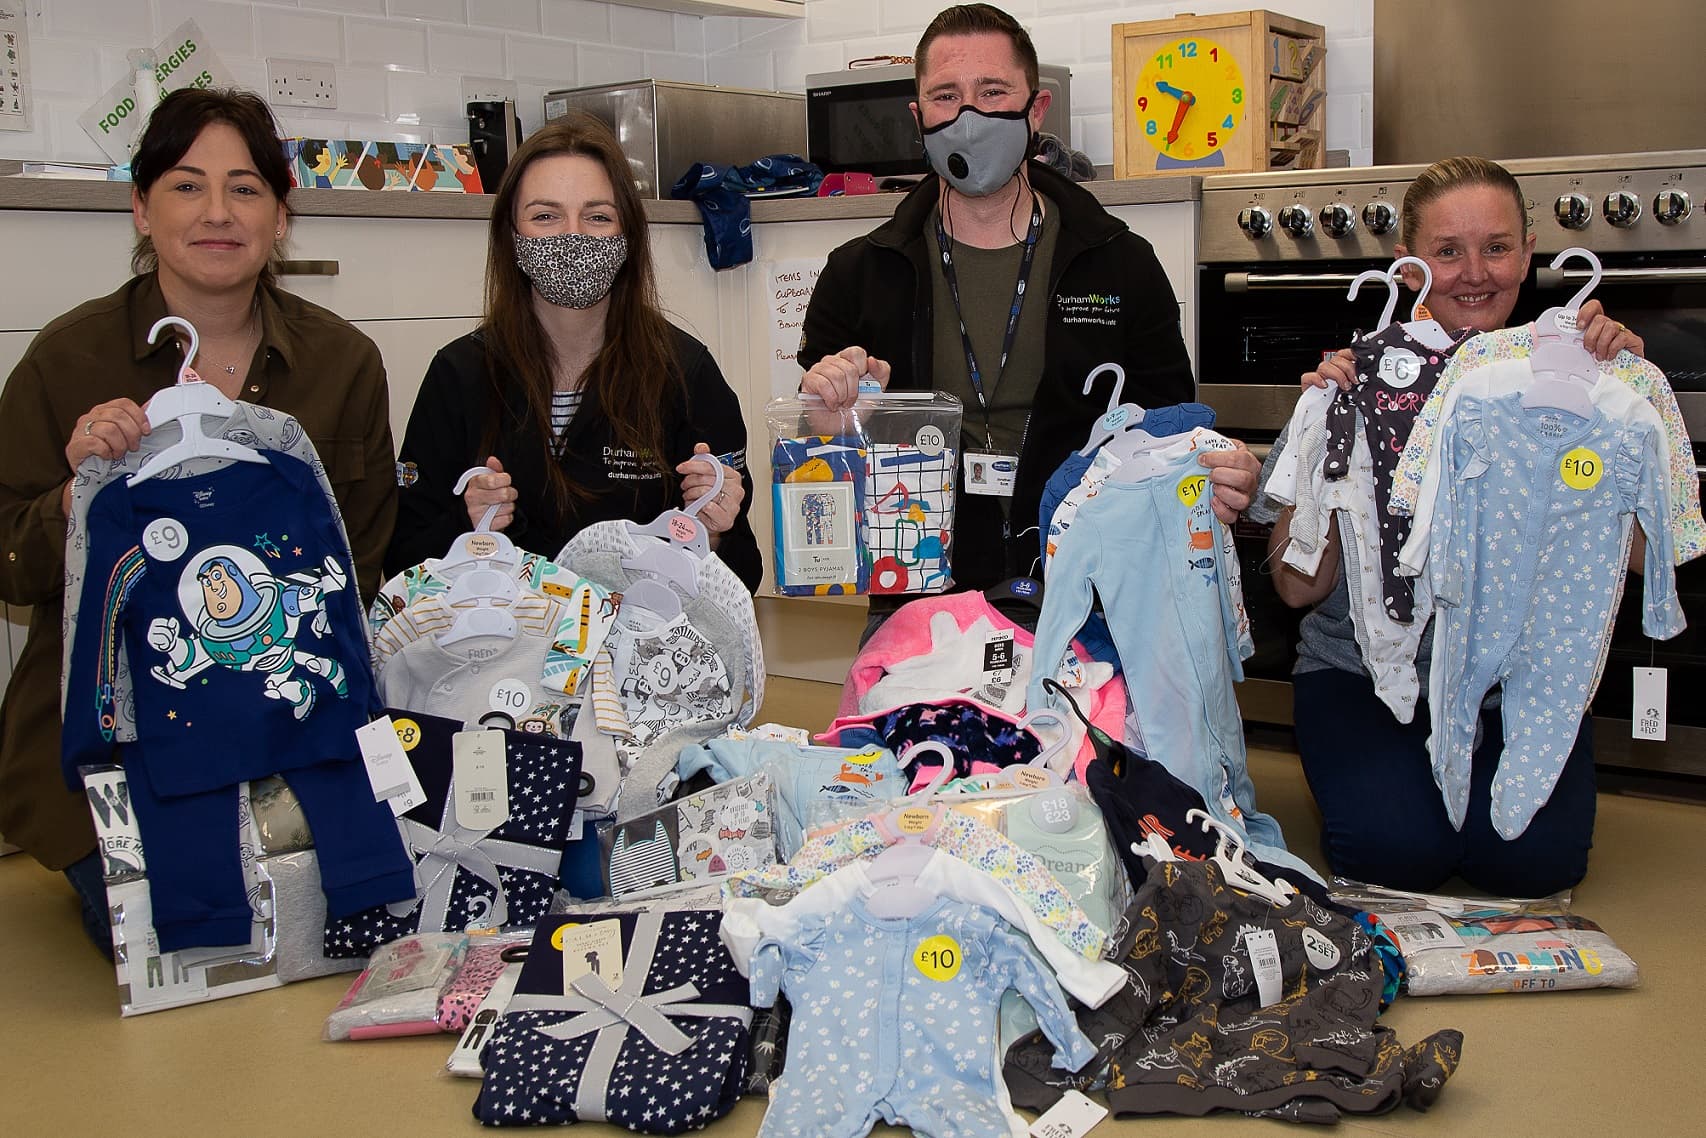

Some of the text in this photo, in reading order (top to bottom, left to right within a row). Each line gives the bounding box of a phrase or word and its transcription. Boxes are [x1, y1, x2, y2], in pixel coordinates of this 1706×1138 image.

[1179, 42, 1198, 58] 12
[1210, 48, 1218, 62] 1
[1157, 54, 1174, 69] 11
[1225, 65, 1236, 81] 2
[98, 97, 136, 134] FOOD
[155, 39, 197, 84] ERGIES
[1232, 88, 1243, 104] 3
[1138, 97, 1149, 112] 9
[1146, 120, 1157, 136] 8
[1222, 114, 1235, 129] 4
[1208, 132, 1218, 148] 5
[1184, 142, 1195, 157] 6
[775, 272, 801, 284] ITEMS
[920, 433, 939, 447] £10
[1565, 458, 1594, 477] £10
[149, 525, 181, 550] £9
[992, 652, 1005, 661] 5-6
[652, 661, 671, 688] £9
[496, 688, 526, 709] £10
[1641, 718, 1659, 727] FRED
[1645, 726, 1657, 734] FLO
[1020, 770, 1045, 781] Newborn
[1041, 798, 1068, 812] £18
[1044, 809, 1071, 823] €23
[1306, 934, 1317, 951] 2
[920, 949, 955, 969] £10
[1318, 944, 1336, 960] SET
[1513, 978, 1555, 989] OFF TO
